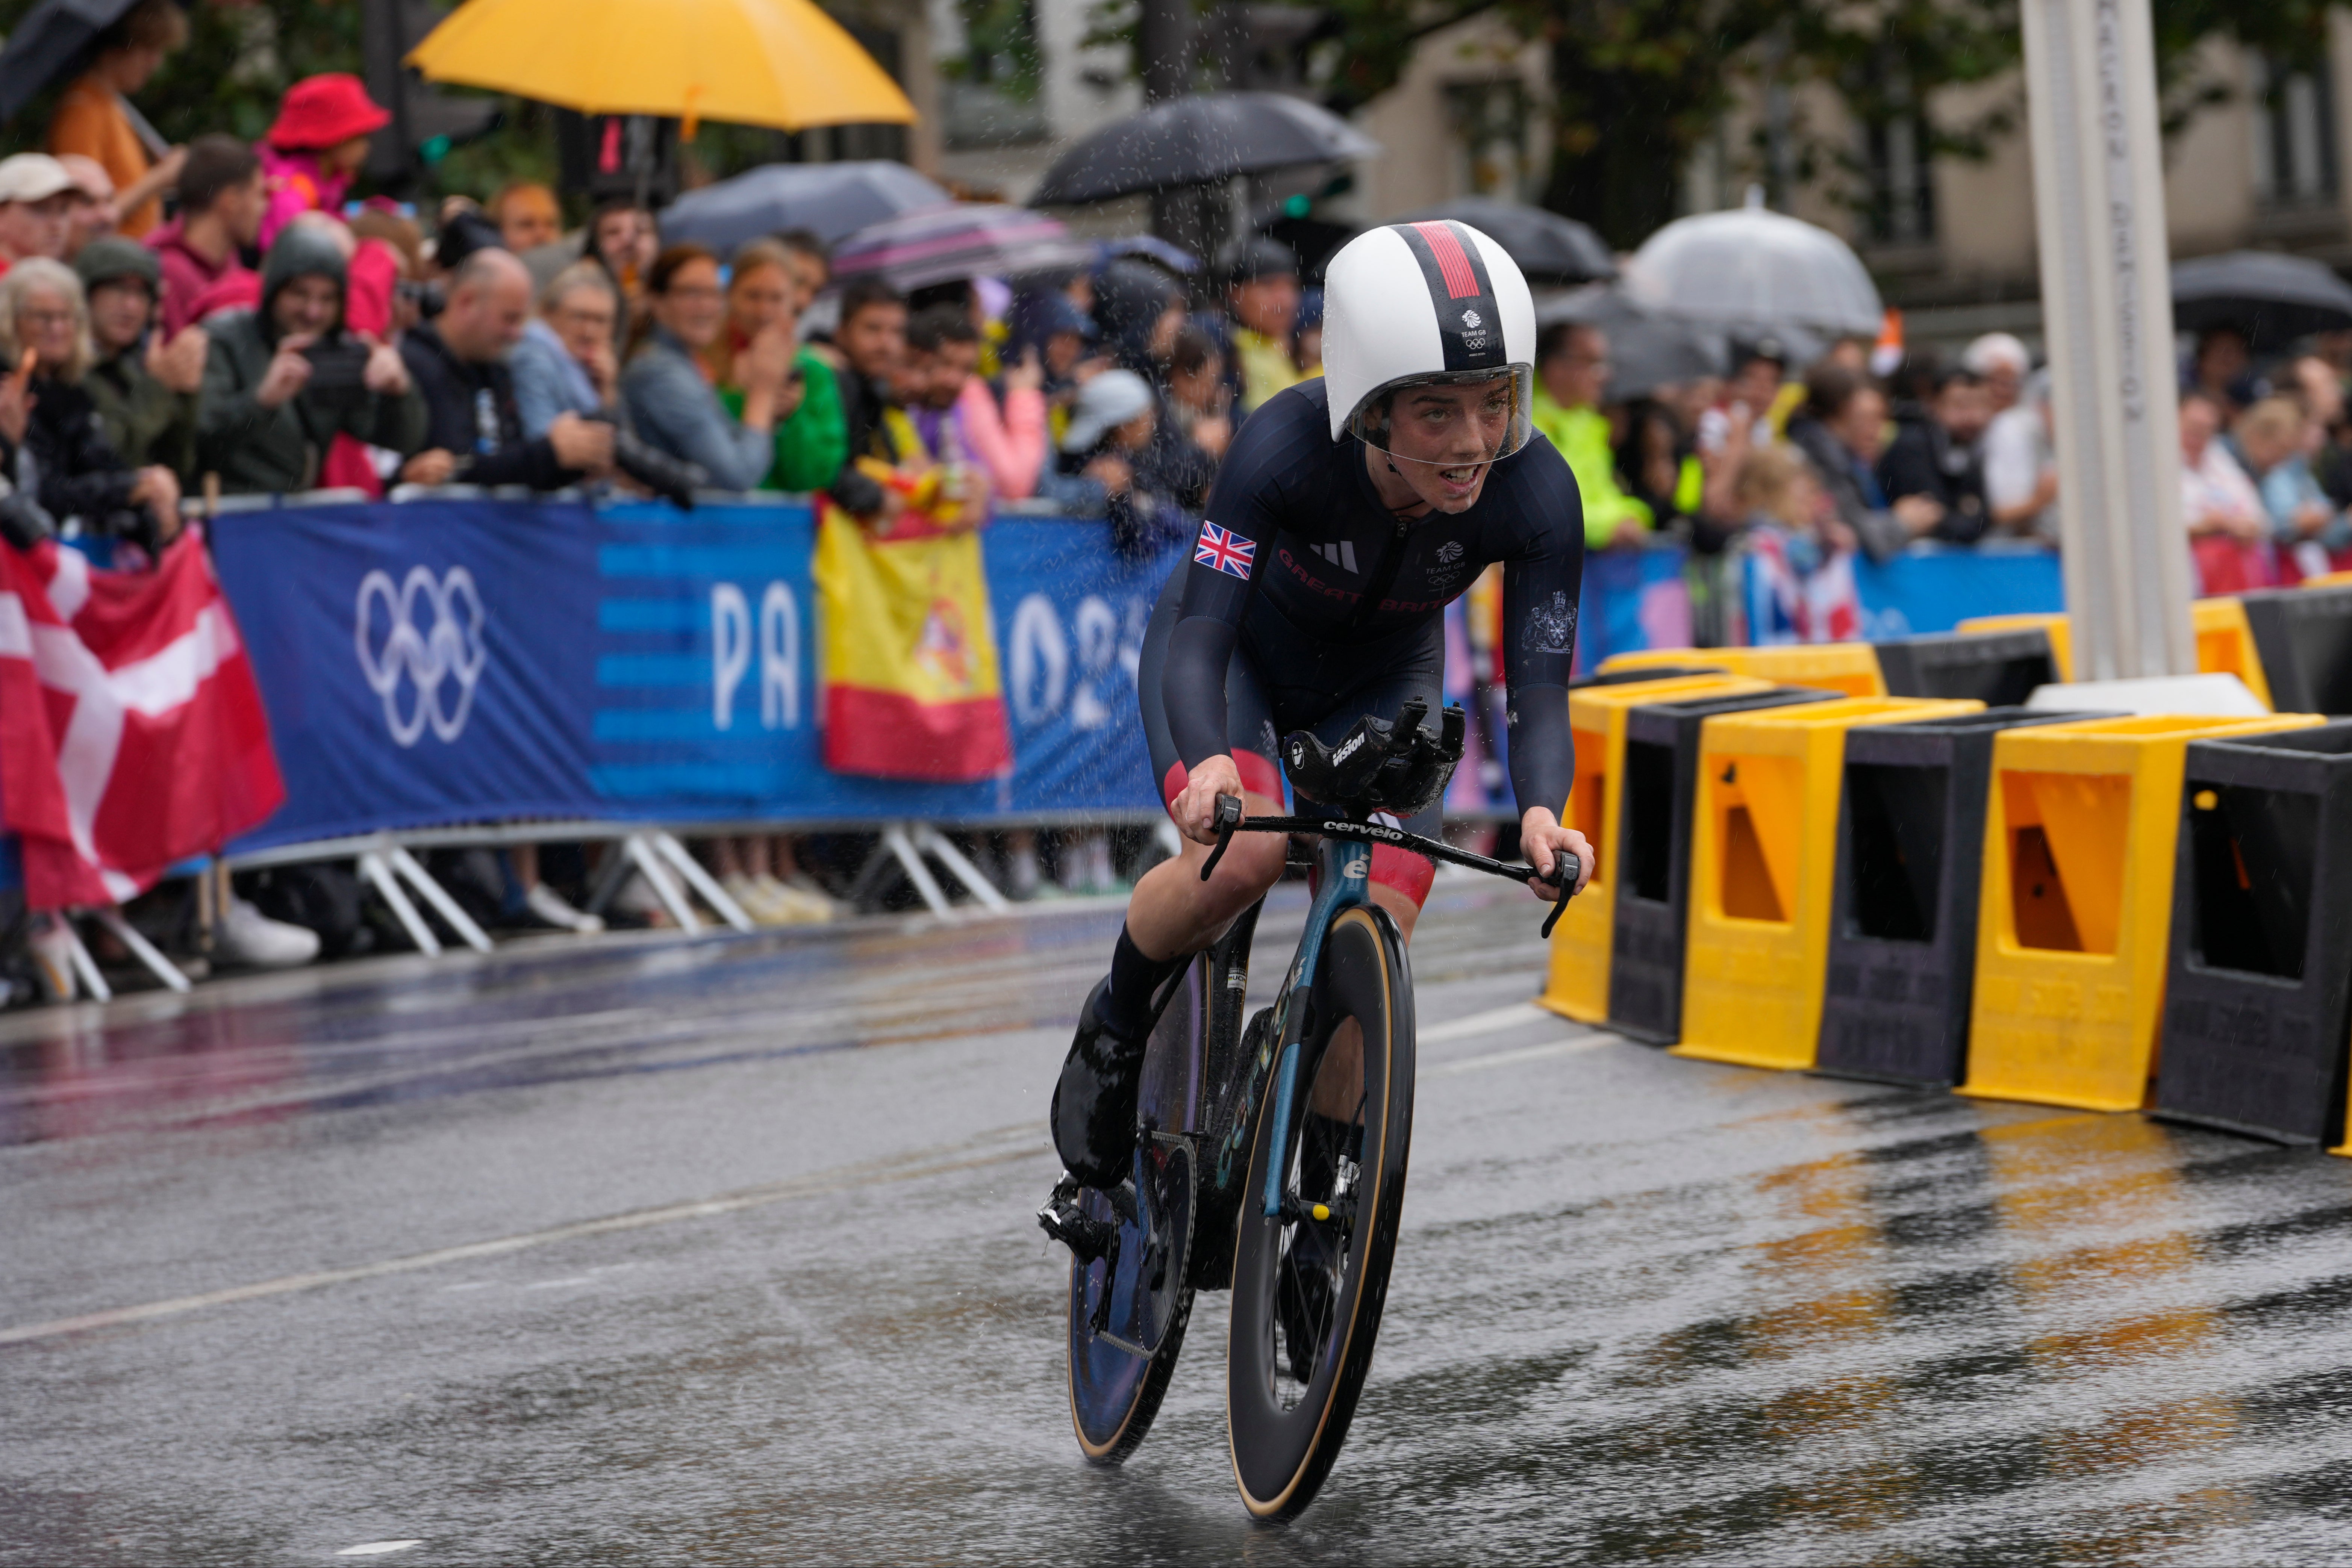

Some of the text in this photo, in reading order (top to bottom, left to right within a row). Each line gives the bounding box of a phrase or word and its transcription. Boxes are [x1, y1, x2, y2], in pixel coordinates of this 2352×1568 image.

[1426, 565, 1451, 574] TEAM
[1279, 549, 1474, 612] GREAT BRITA
[1323, 821, 1403, 840] cervélo
